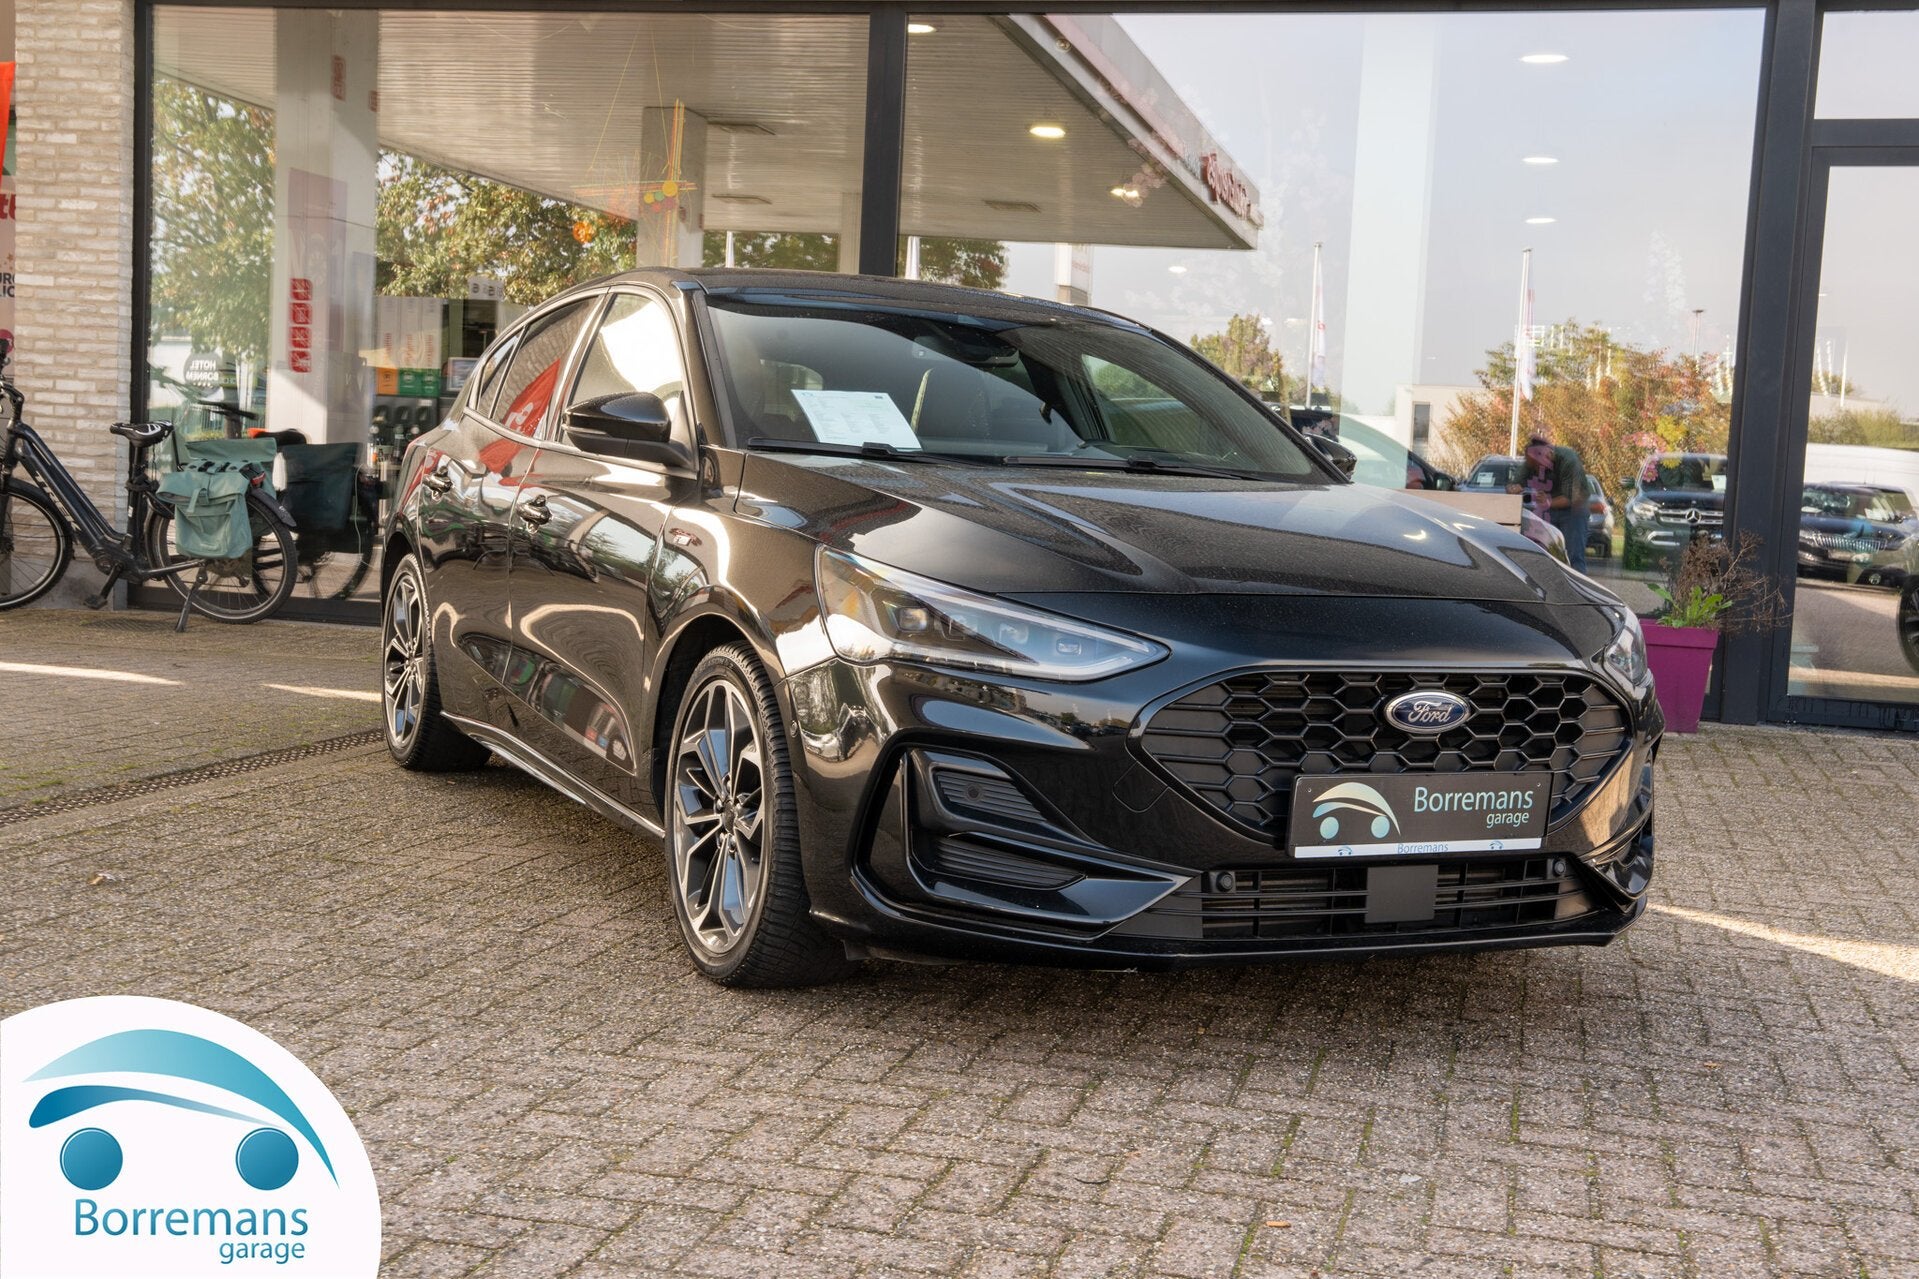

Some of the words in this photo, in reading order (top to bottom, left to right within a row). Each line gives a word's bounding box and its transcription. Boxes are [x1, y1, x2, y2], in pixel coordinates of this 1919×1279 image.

[1407, 700, 1452, 723] Ford
[1413, 786, 1534, 813] Borremans
[1486, 811, 1530, 829] garage
[1397, 842, 1449, 855] Borremans
